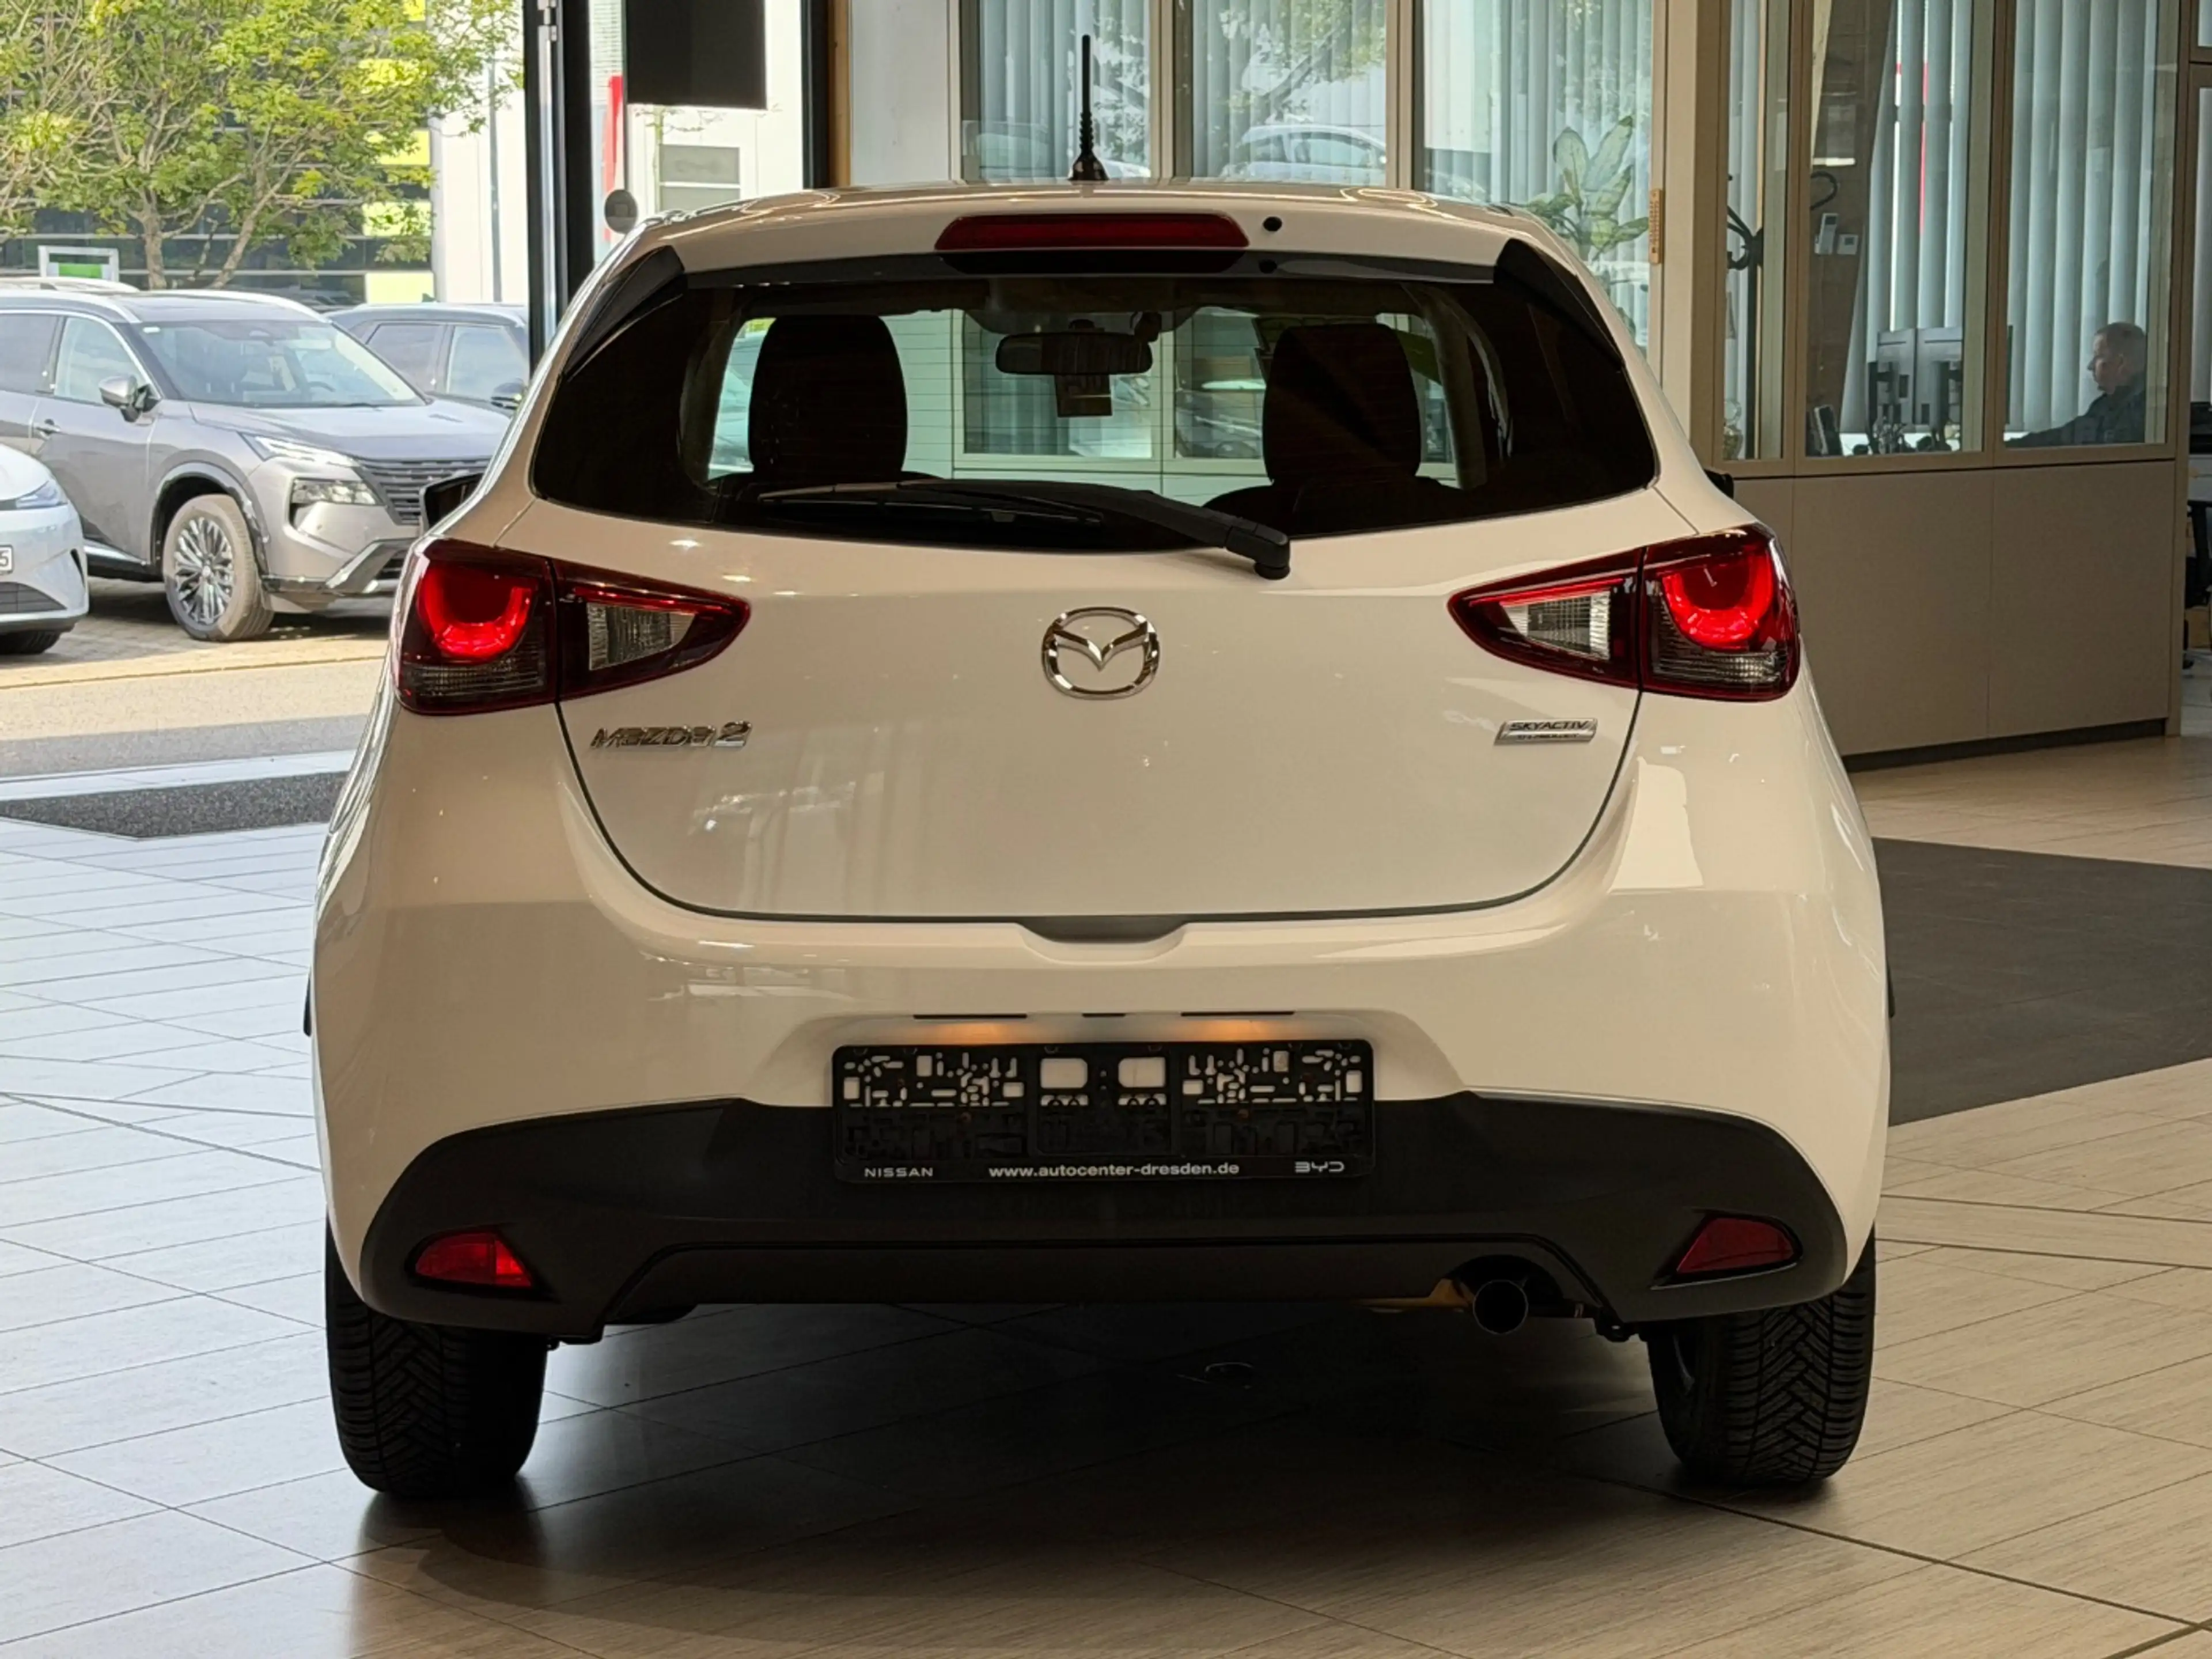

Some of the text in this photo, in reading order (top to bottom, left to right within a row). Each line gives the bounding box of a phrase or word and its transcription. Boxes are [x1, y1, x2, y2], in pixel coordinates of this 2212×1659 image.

[1509, 721, 1589, 730] SKYACTIV
[865, 1167, 933, 1177] NISSAN
[988, 1162, 1240, 1177] www.autocenter-dresden.de
[1294, 1161, 1345, 1173] BYD
